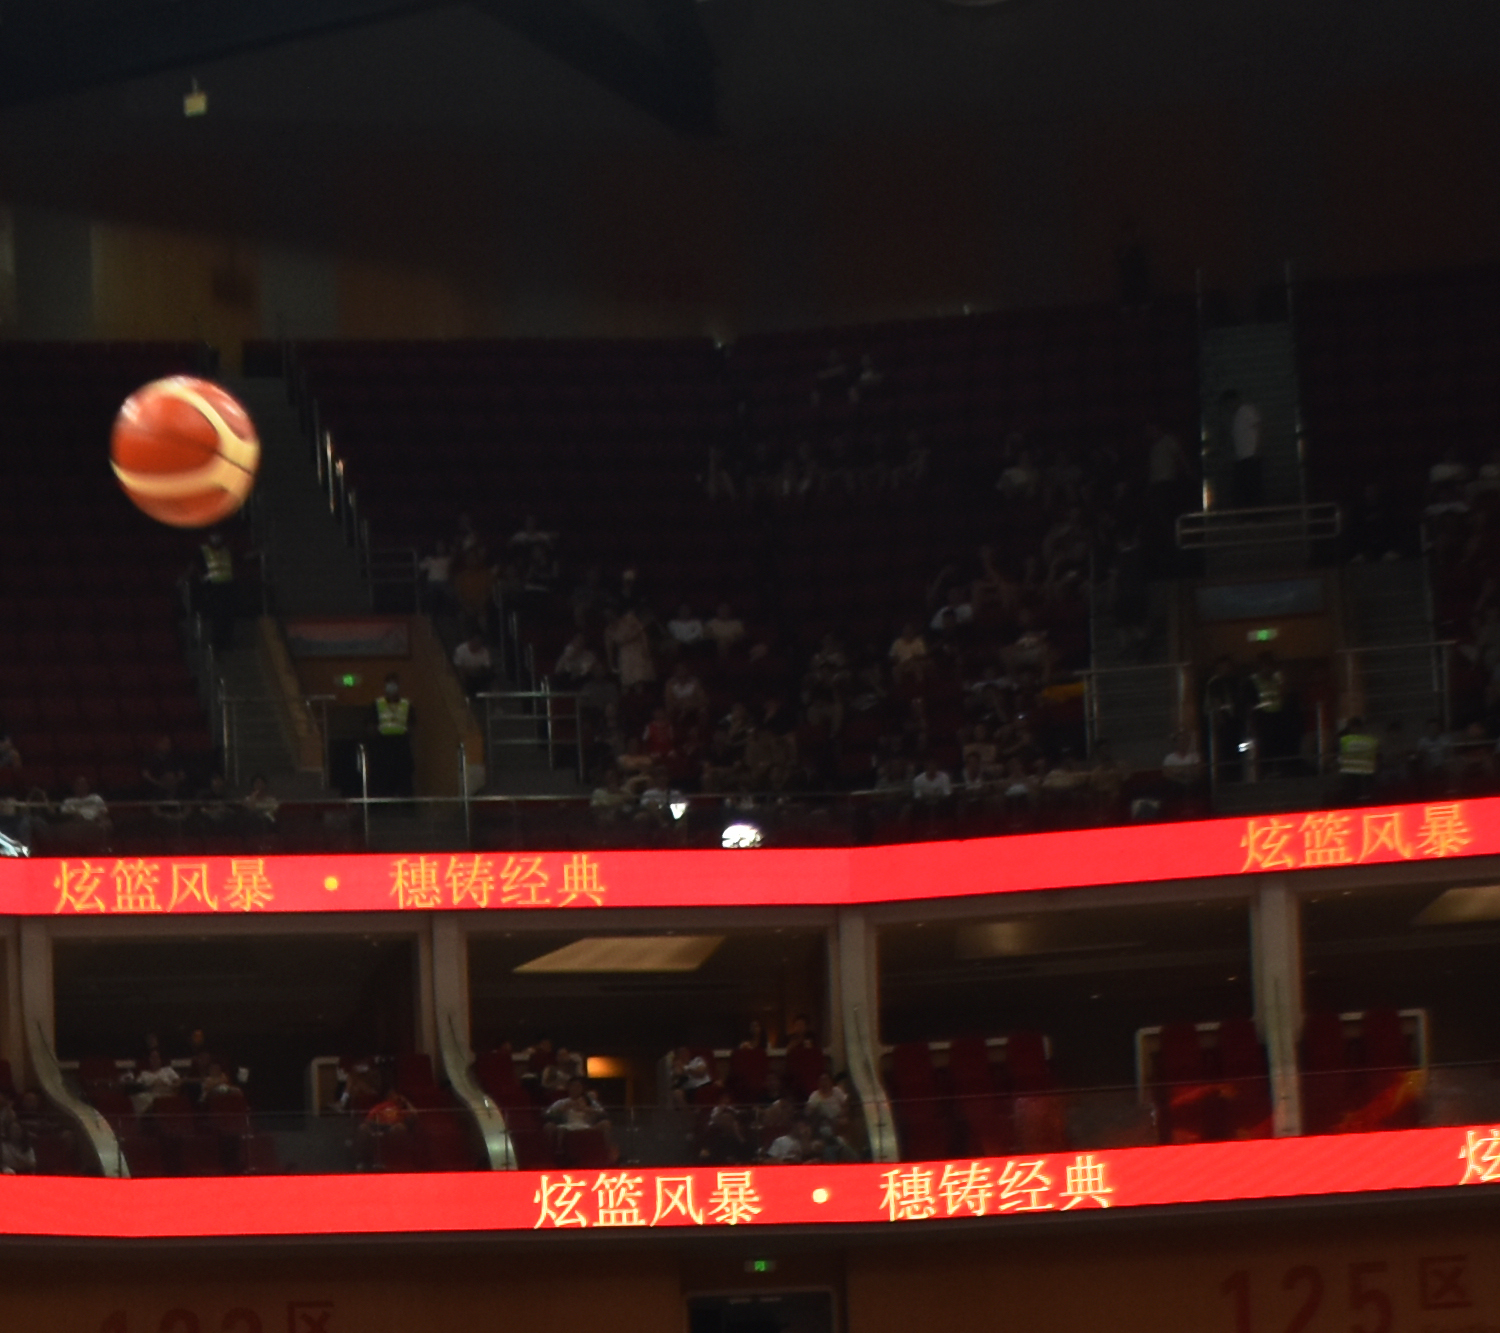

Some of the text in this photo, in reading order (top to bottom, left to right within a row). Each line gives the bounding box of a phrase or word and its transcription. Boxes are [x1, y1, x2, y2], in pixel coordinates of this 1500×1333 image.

[1239, 801, 1474, 874] 炫篮风暴
[52, 853, 608, 915] 炫篮风暴 穗铸经典
[532, 1153, 1117, 1230] 炫篮风暴 穗铸经典
[1417, 1253, 1474, 1310] 区
